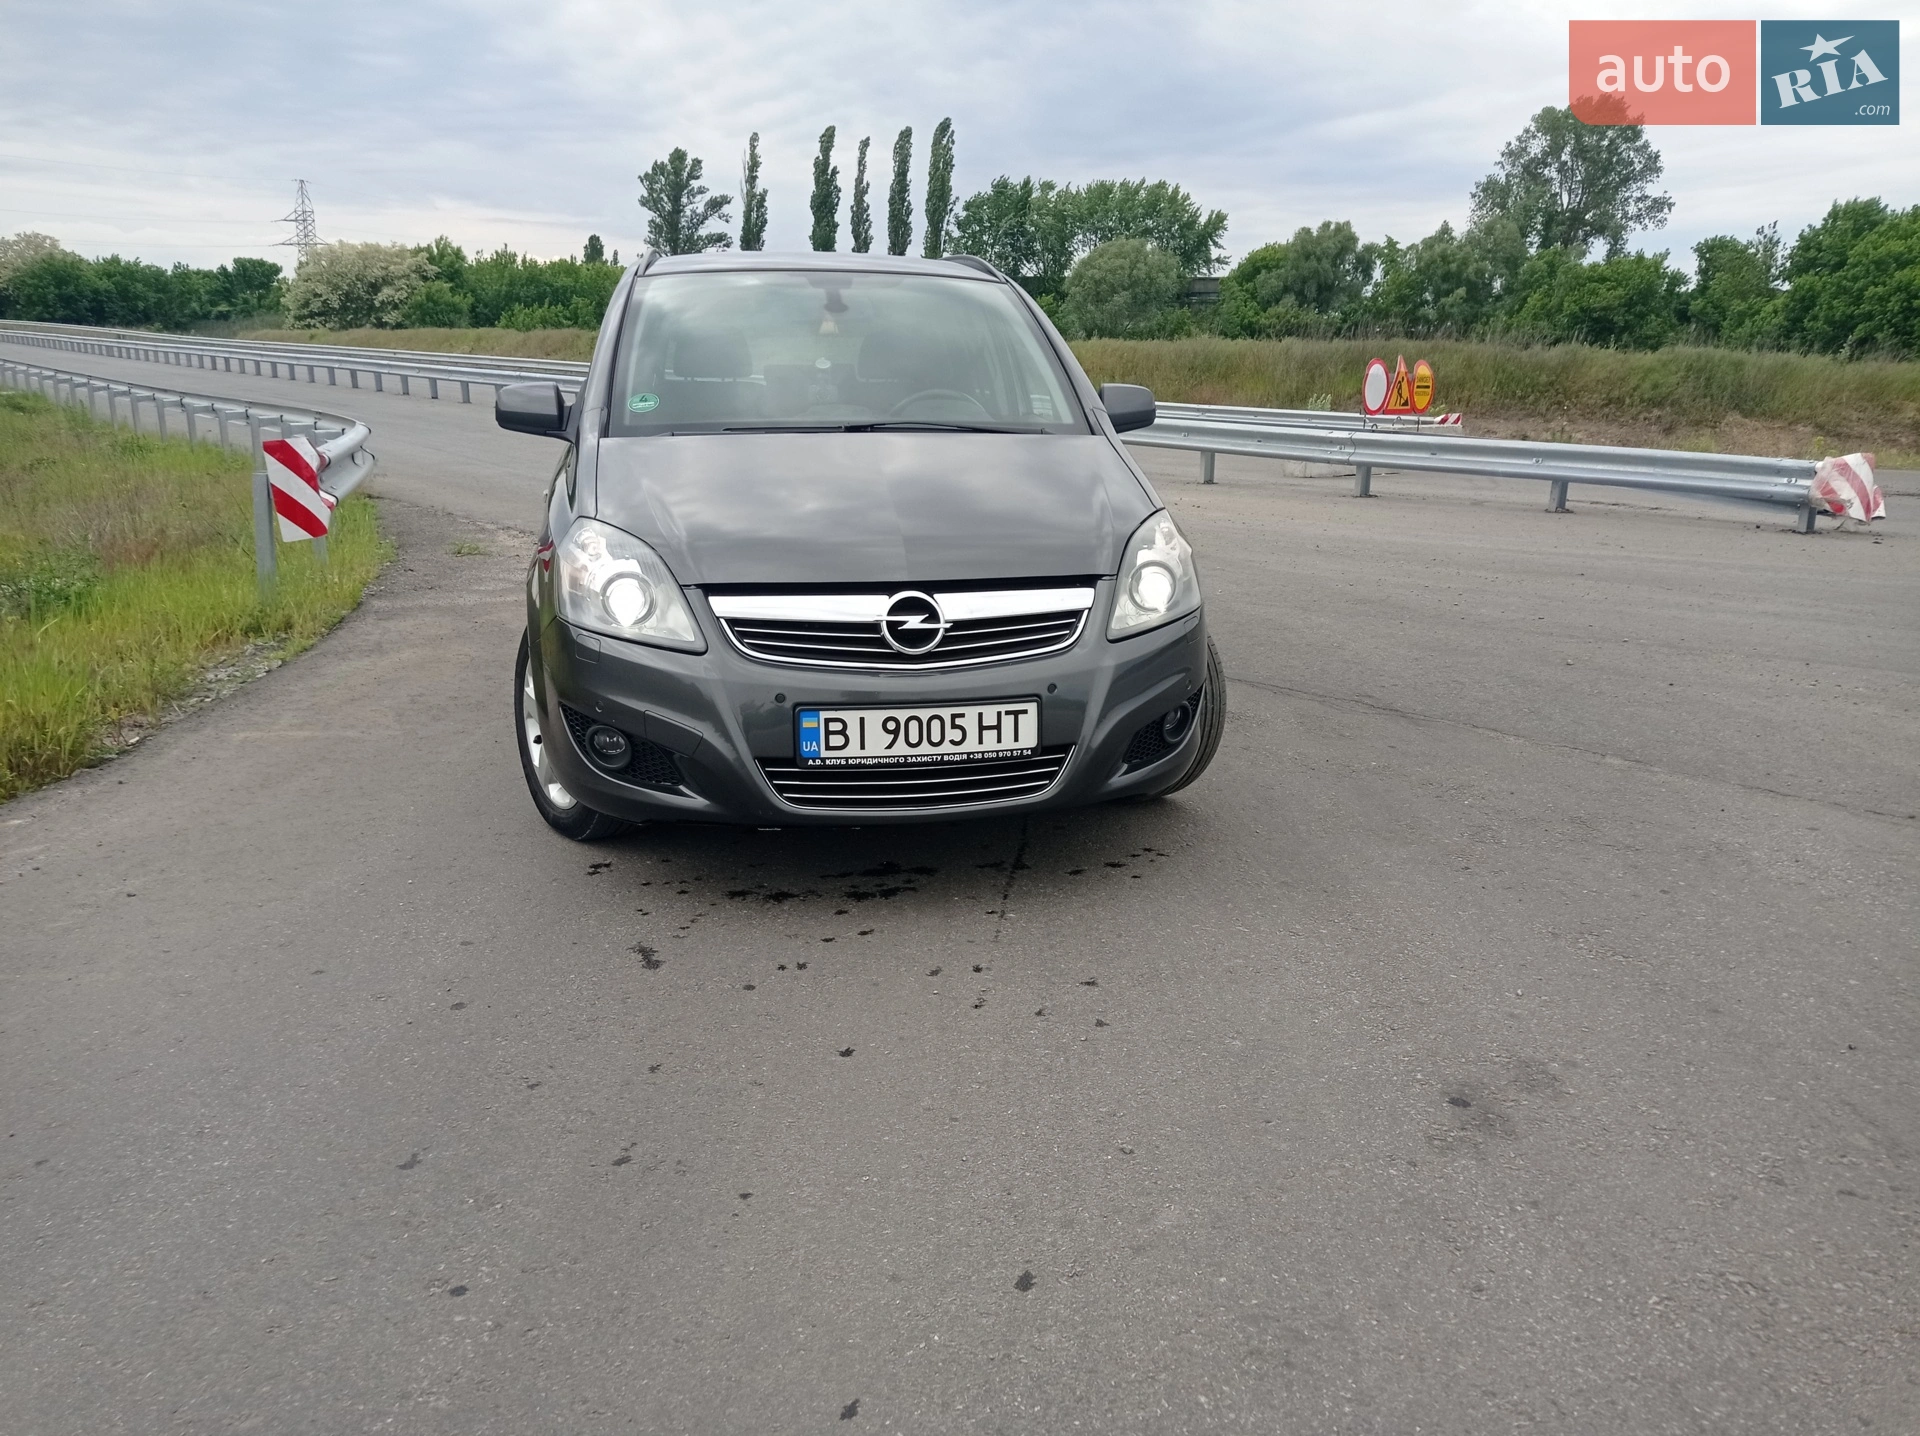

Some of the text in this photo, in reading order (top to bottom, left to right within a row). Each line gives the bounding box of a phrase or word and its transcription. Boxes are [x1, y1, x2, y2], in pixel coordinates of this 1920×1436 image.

[824, 709, 1029, 751] BI 9005 HT
[802, 740, 819, 752] UA
[907, 755, 942, 763] ЗАХИСТУ
